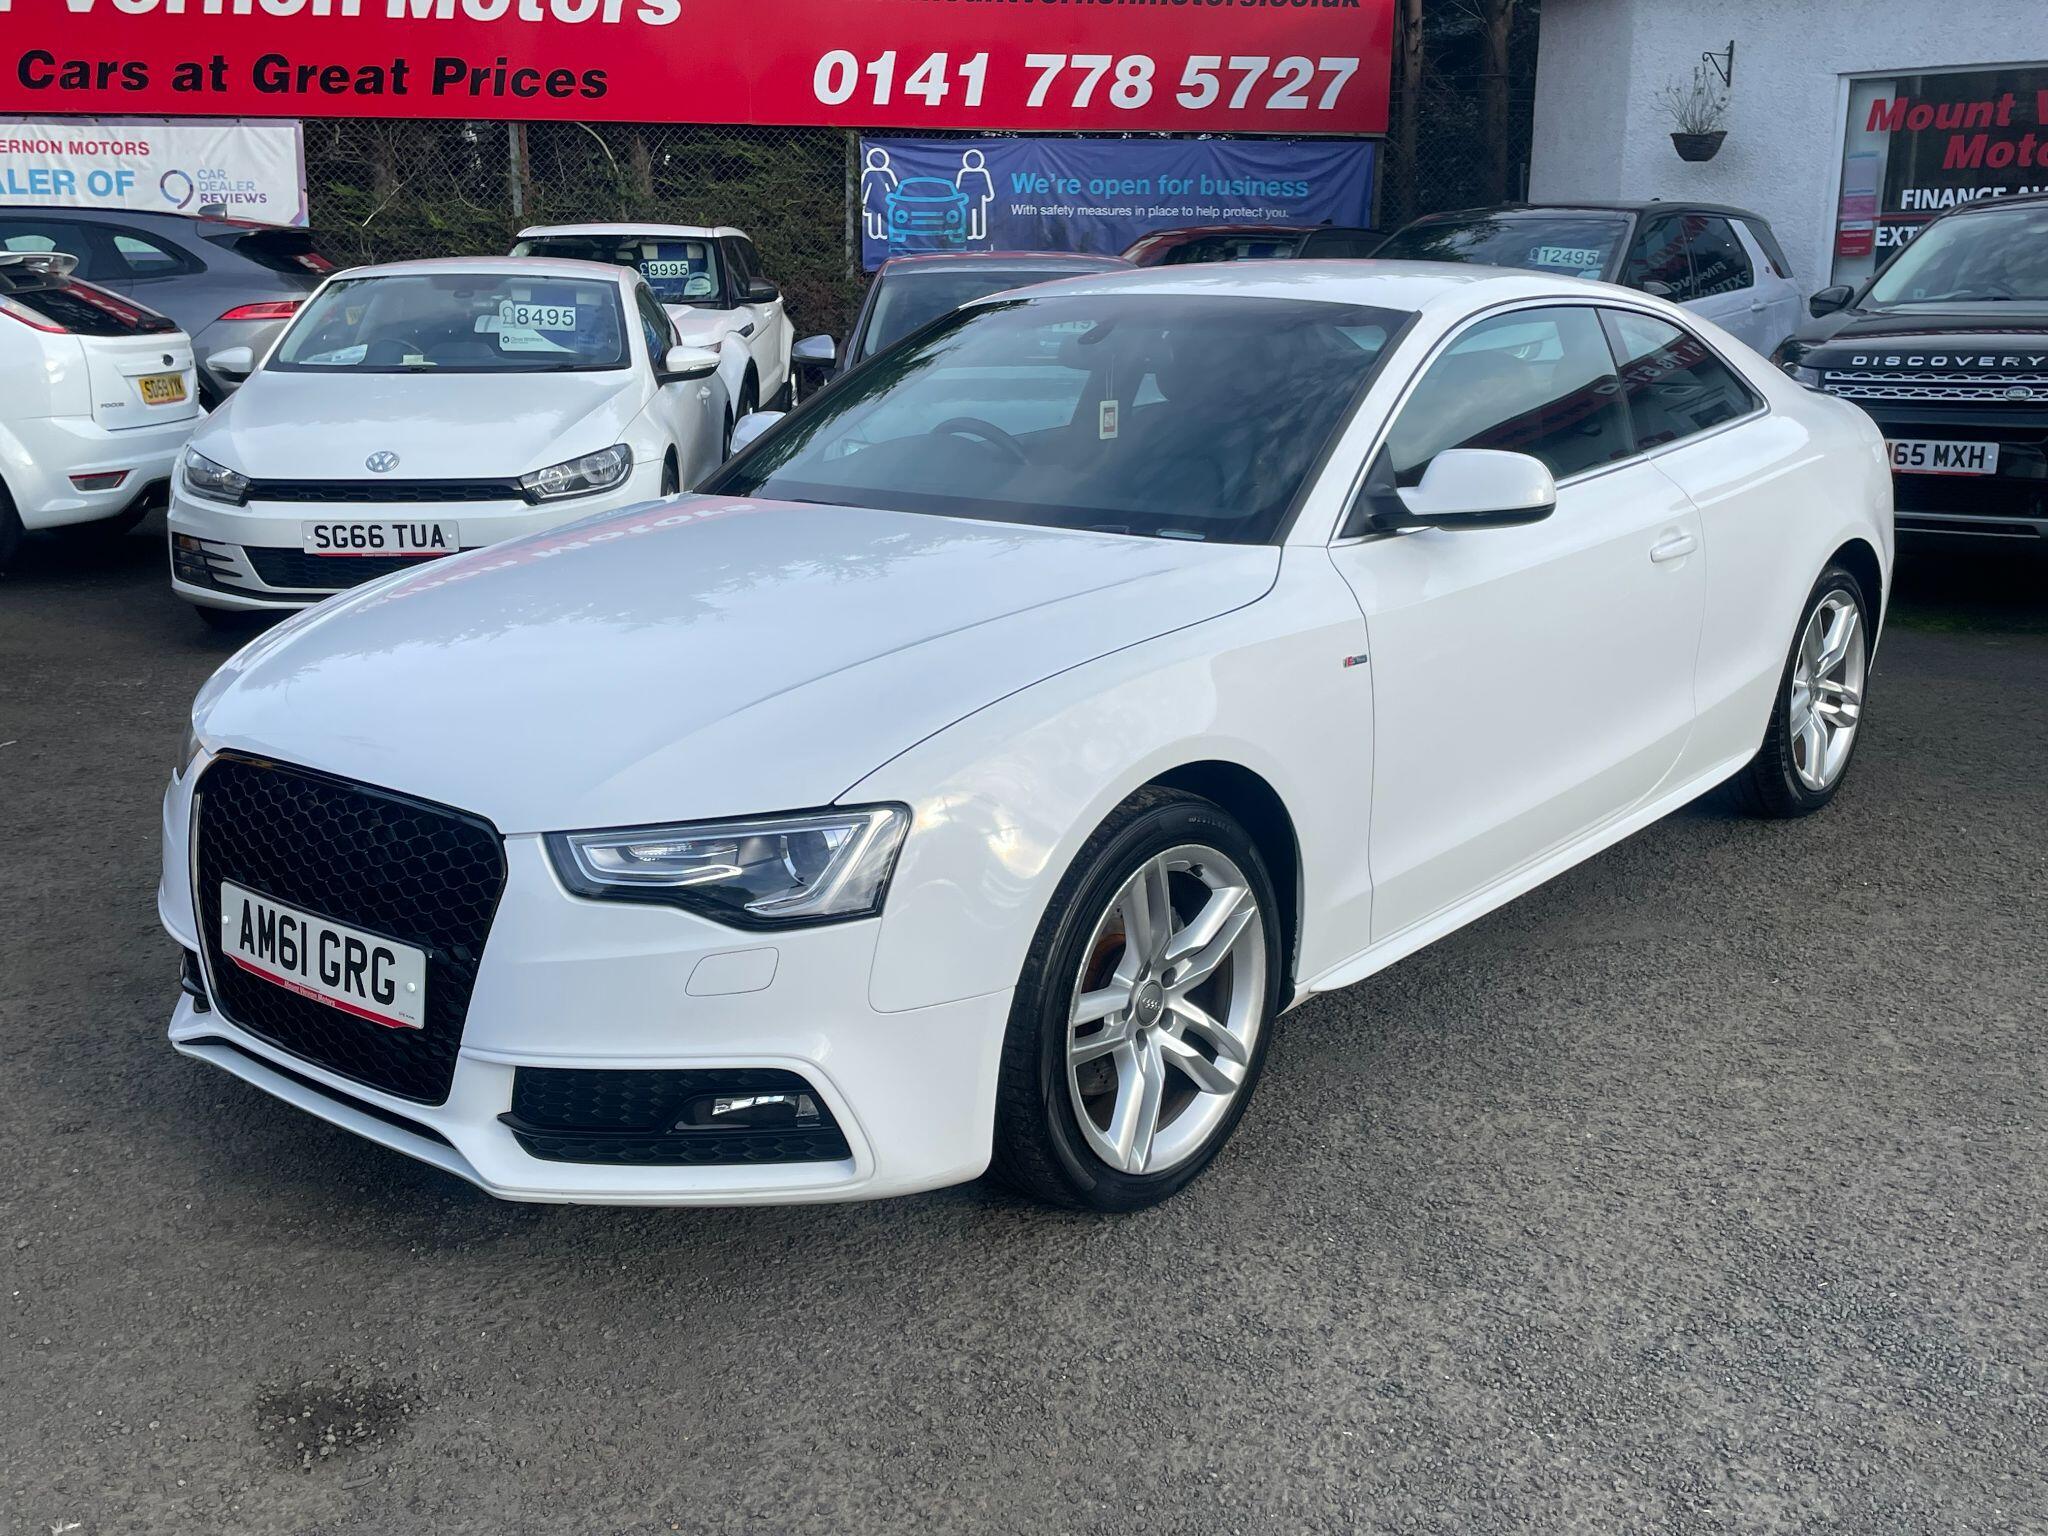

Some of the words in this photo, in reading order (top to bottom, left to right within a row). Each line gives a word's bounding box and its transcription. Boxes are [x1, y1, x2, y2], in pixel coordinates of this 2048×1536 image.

[17, 50, 149, 91] Cars
[172, 55, 229, 92] at
[252, 52, 410, 96] Great
[431, 56, 609, 99] Prices
[812, 50, 990, 107] 0141
[1023, 53, 1156, 110] 778
[1175, 55, 1361, 111] 5727
[1866, 92, 2016, 132] Mount
[68, 140, 151, 156] MOTORS
[87, 169, 136, 197] OF
[197, 169, 228, 179] CAR
[198, 180, 256, 192] DEALER
[1011, 172, 1082, 195] We're
[1089, 177, 1151, 200] open
[1158, 174, 1194, 196] for
[1200, 174, 1310, 197] business
[200, 192, 268, 204] REVIEWS
[1011, 204, 1038, 216] With
[1040, 204, 1075, 218] safety
[1077, 206, 1132, 217] measures
[1135, 206, 1146, 217] in
[1148, 206, 1180, 219] place
[1182, 206, 1194, 218] to
[1196, 206, 1221, 219] help
[1223, 207, 1263, 220] protect
[1265, 209, 1290, 221] you.
[639, 262, 689, 276] £9995
[1851, 355, 2047, 367] DISCOVERY
[1933, 445, 1986, 469] MXH
[314, 524, 385, 549] SG66
[392, 524, 446, 548] TUA
[239, 898, 308, 977] AM61
[319, 929, 396, 1006] GRG
